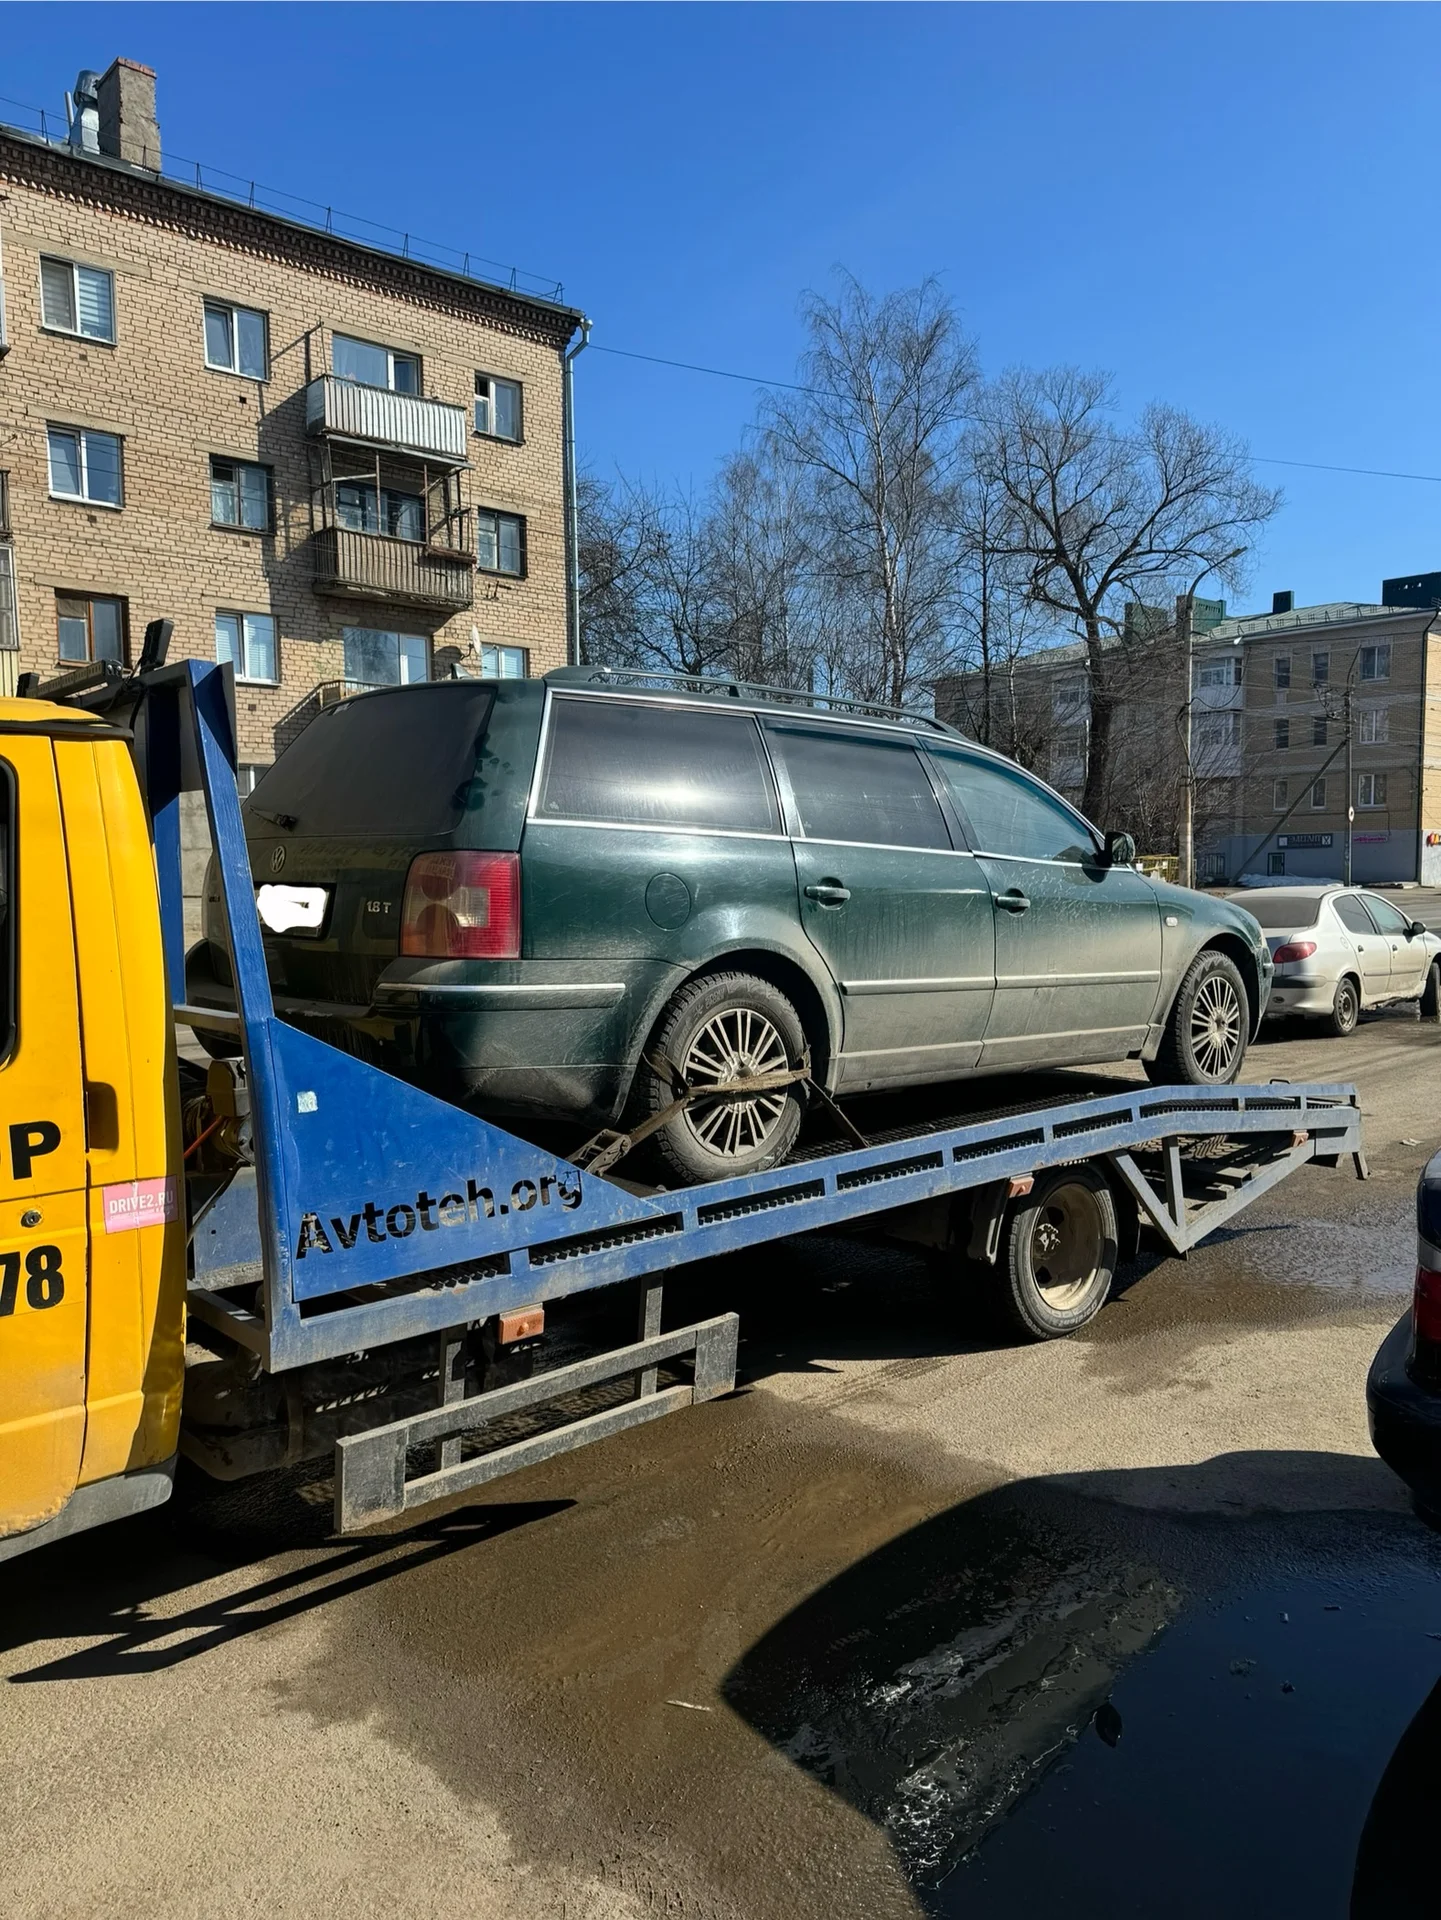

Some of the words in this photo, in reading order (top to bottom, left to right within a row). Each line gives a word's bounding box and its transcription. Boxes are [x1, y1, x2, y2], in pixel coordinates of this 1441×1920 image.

[383, 901, 392, 914] T
[109, 1190, 174, 1214] DRIVE2.RU
[296, 1170, 583, 1259] Avtoteh.org
